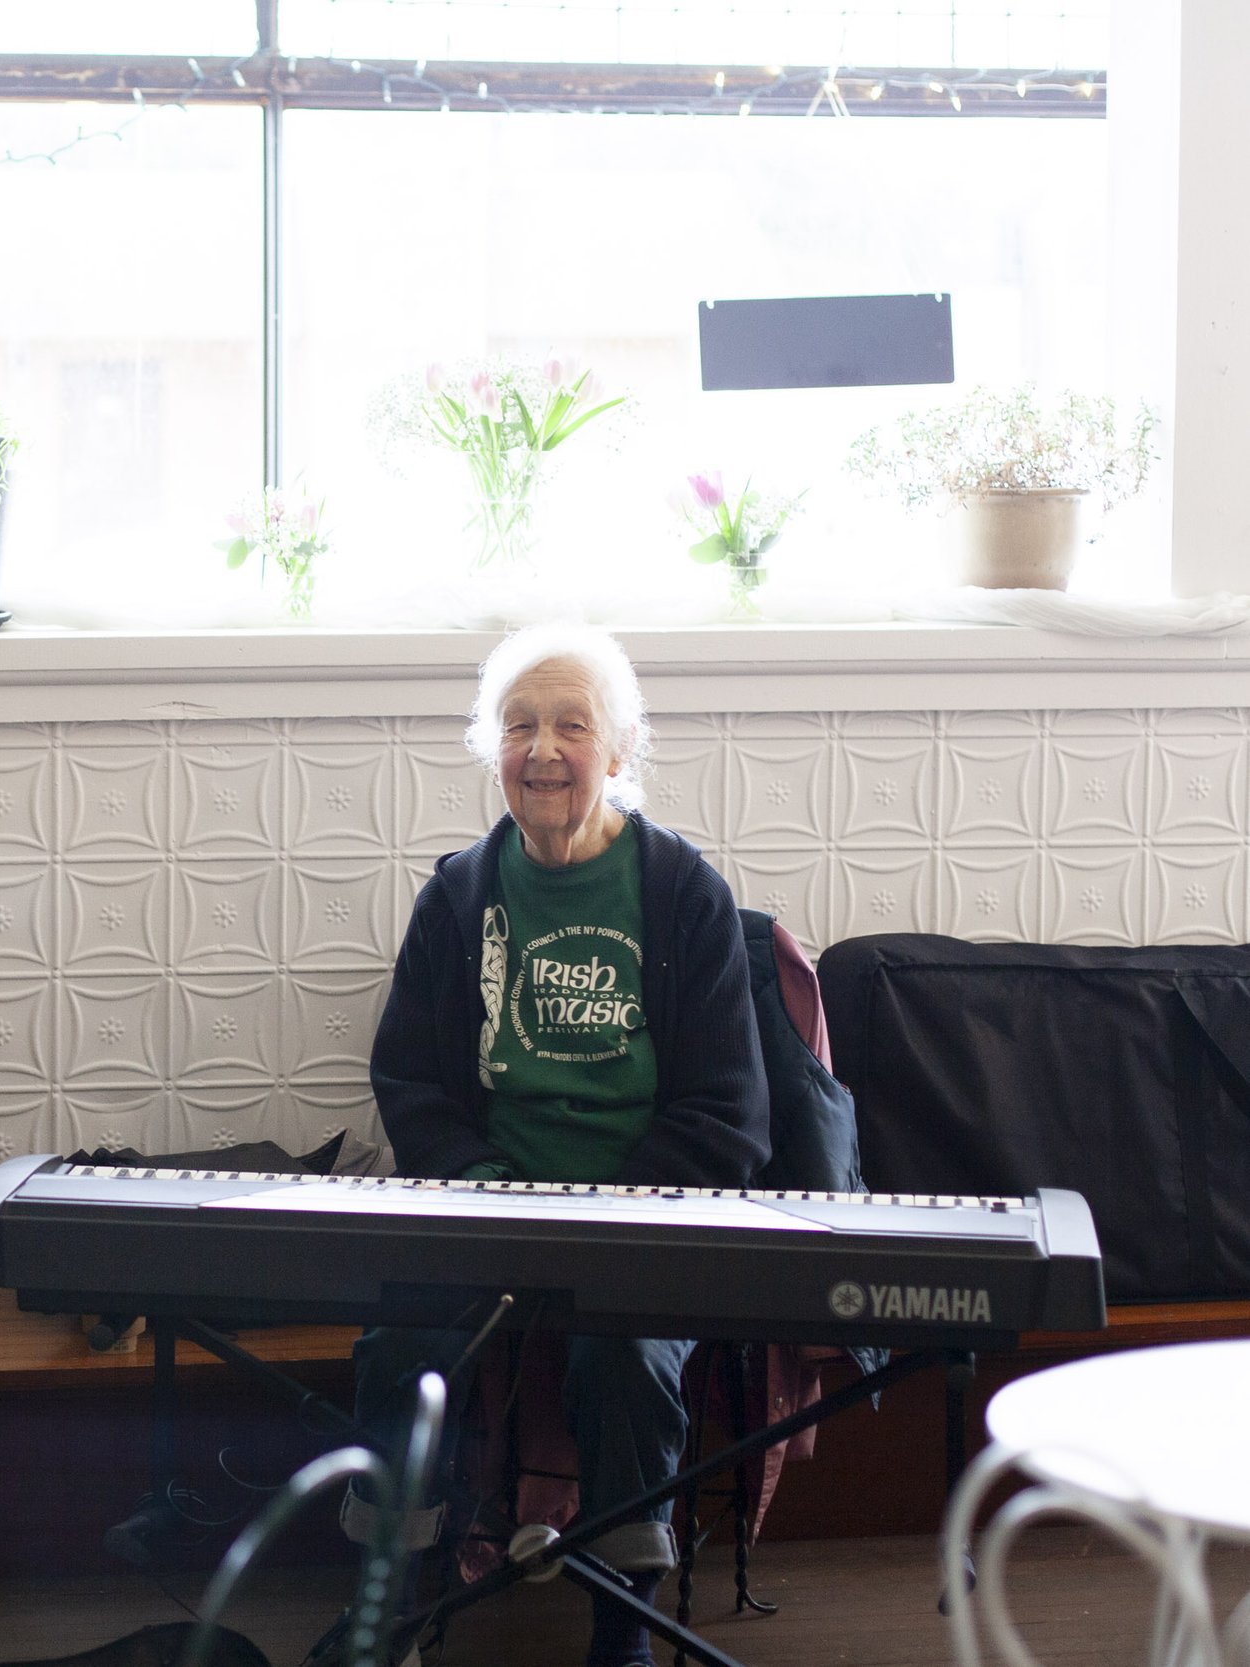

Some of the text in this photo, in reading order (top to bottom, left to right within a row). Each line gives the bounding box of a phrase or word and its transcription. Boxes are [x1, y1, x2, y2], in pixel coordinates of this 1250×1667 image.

[558, 928, 566, 938] &
[565, 926, 582, 936] THE
[583, 925, 596, 935] NY
[597, 927, 625, 942] POWER
[527, 932, 559, 950] COUNCIL
[511, 969, 526, 999] COUNTY
[537, 1026, 601, 1034] FESTIVAL
[520, 1036, 534, 1051] THE
[869, 1284, 992, 1323] YAMAHA
